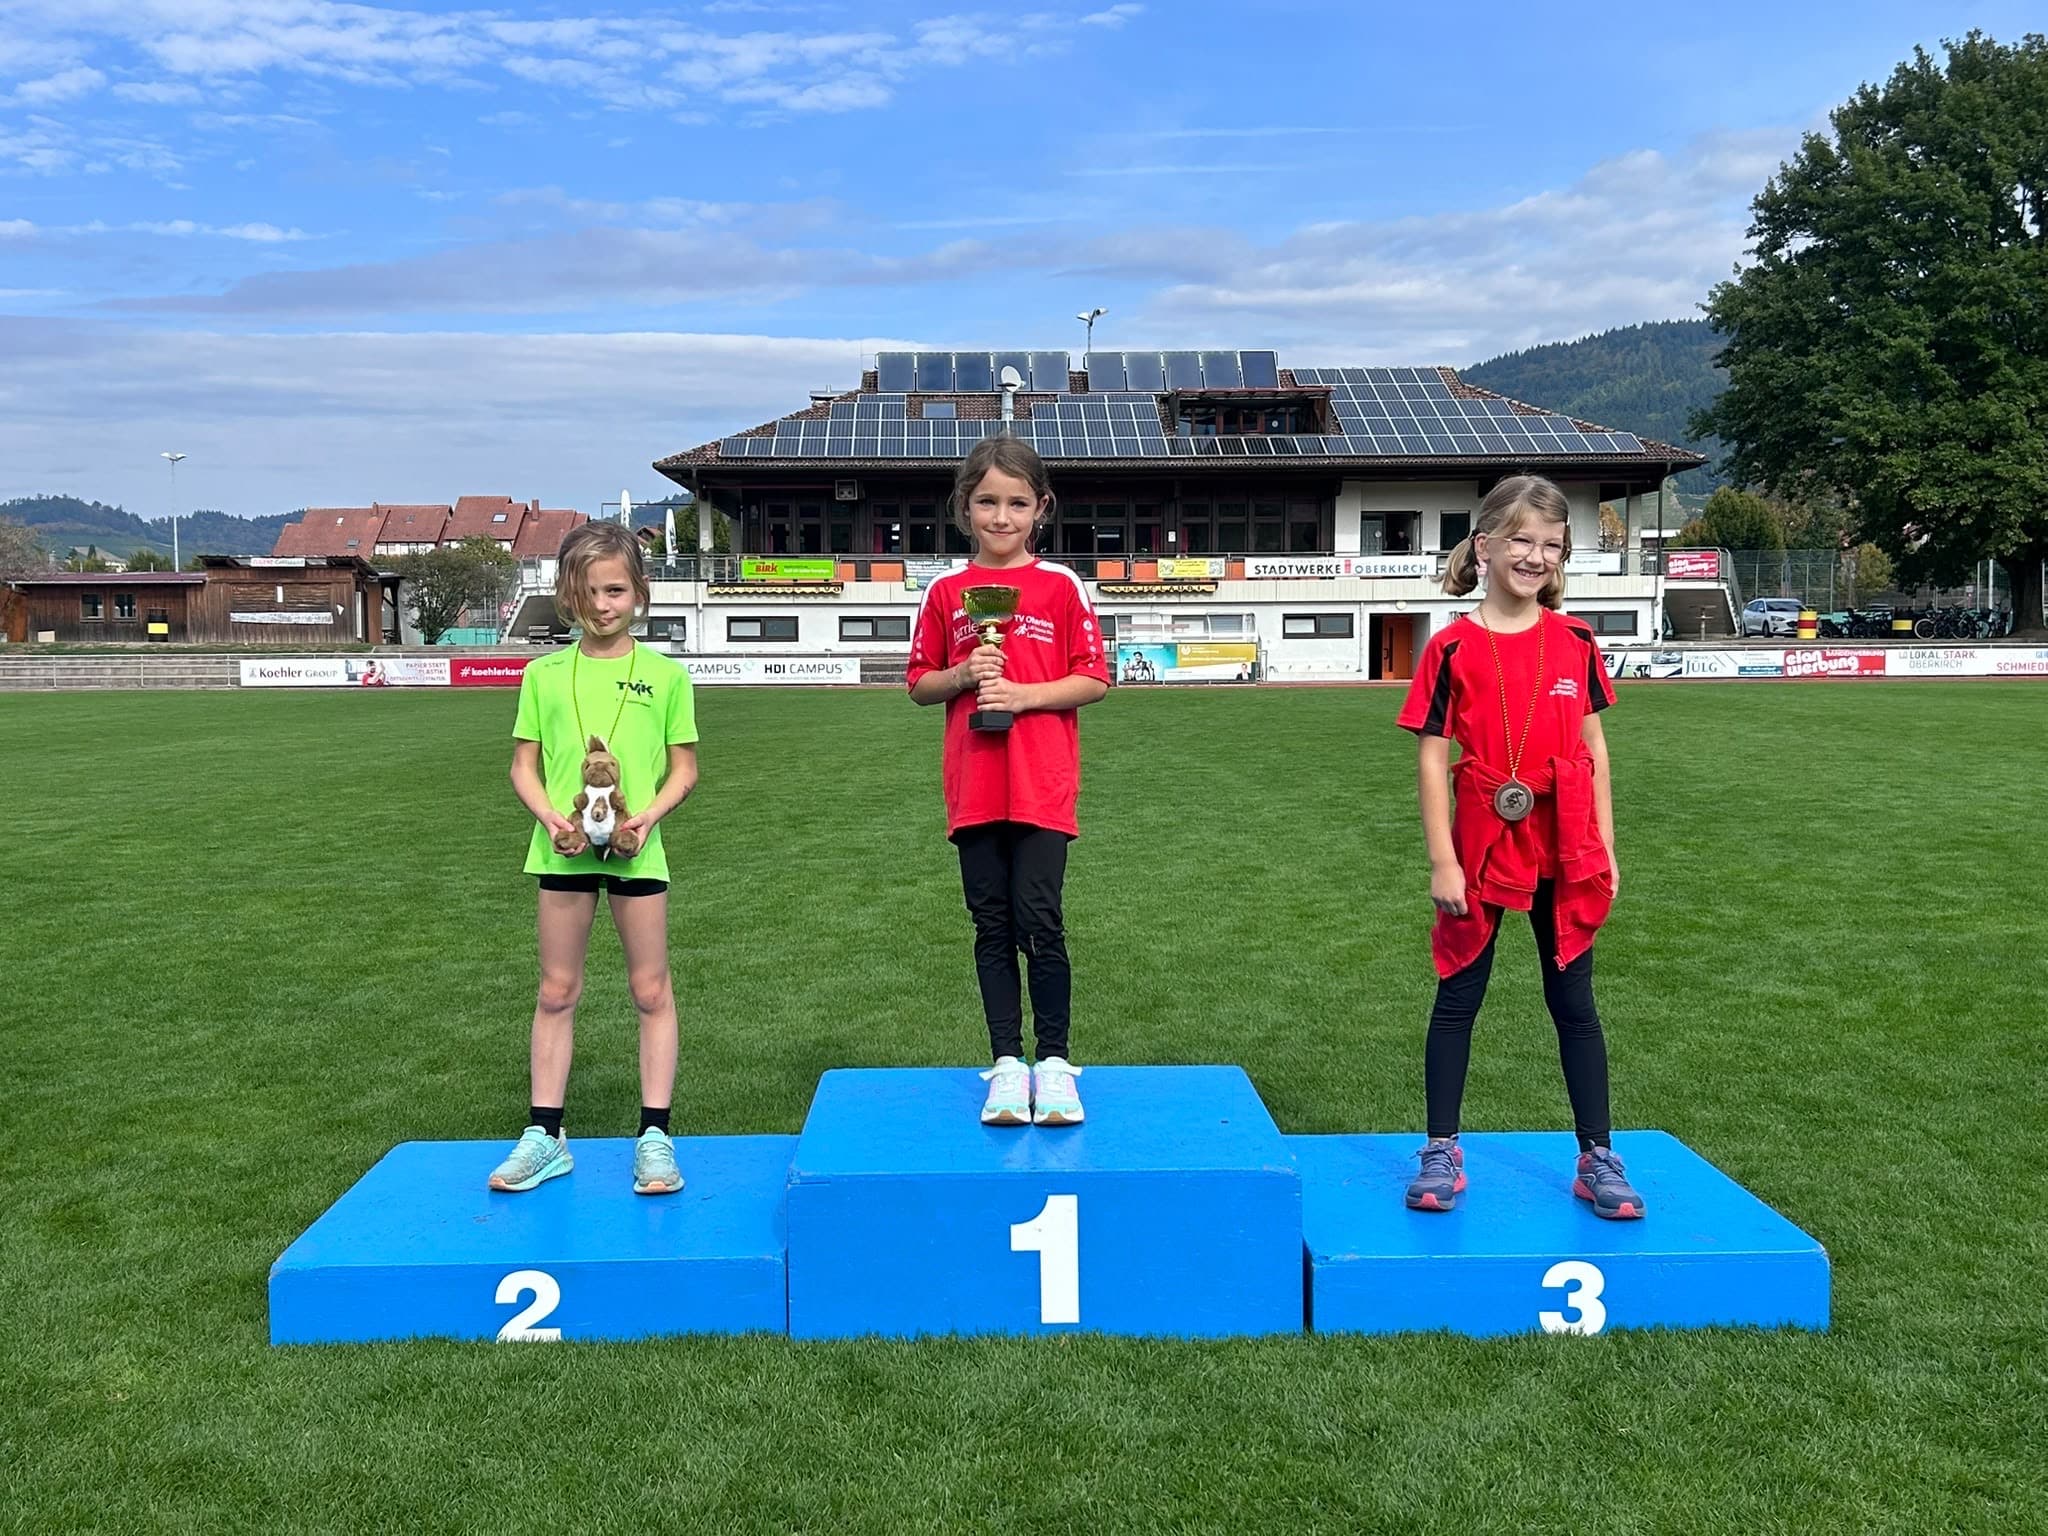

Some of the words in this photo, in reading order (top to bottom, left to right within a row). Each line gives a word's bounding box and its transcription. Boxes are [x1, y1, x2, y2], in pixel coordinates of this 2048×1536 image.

[1254, 564, 1341, 575] STADTWERKE
[1355, 563, 1427, 574] OBERKIRCH
[1014, 614, 1025, 622] TV
[1785, 650, 1822, 665] elan
[687, 663, 741, 674] CAMPUS
[764, 664, 786, 674] HDI
[789, 663, 843, 674] CAMPUS
[1786, 656, 1859, 676] werbung
[1909, 659, 1962, 669] OBERKIRCH
[1996, 662, 2048, 671] SCHMIED
[259, 667, 302, 679] Koehler
[305, 669, 338, 678] GROUP
[1010, 1194, 1080, 1324] 1
[1539, 1260, 1607, 1337] 3
[495, 1269, 561, 1344] 2
